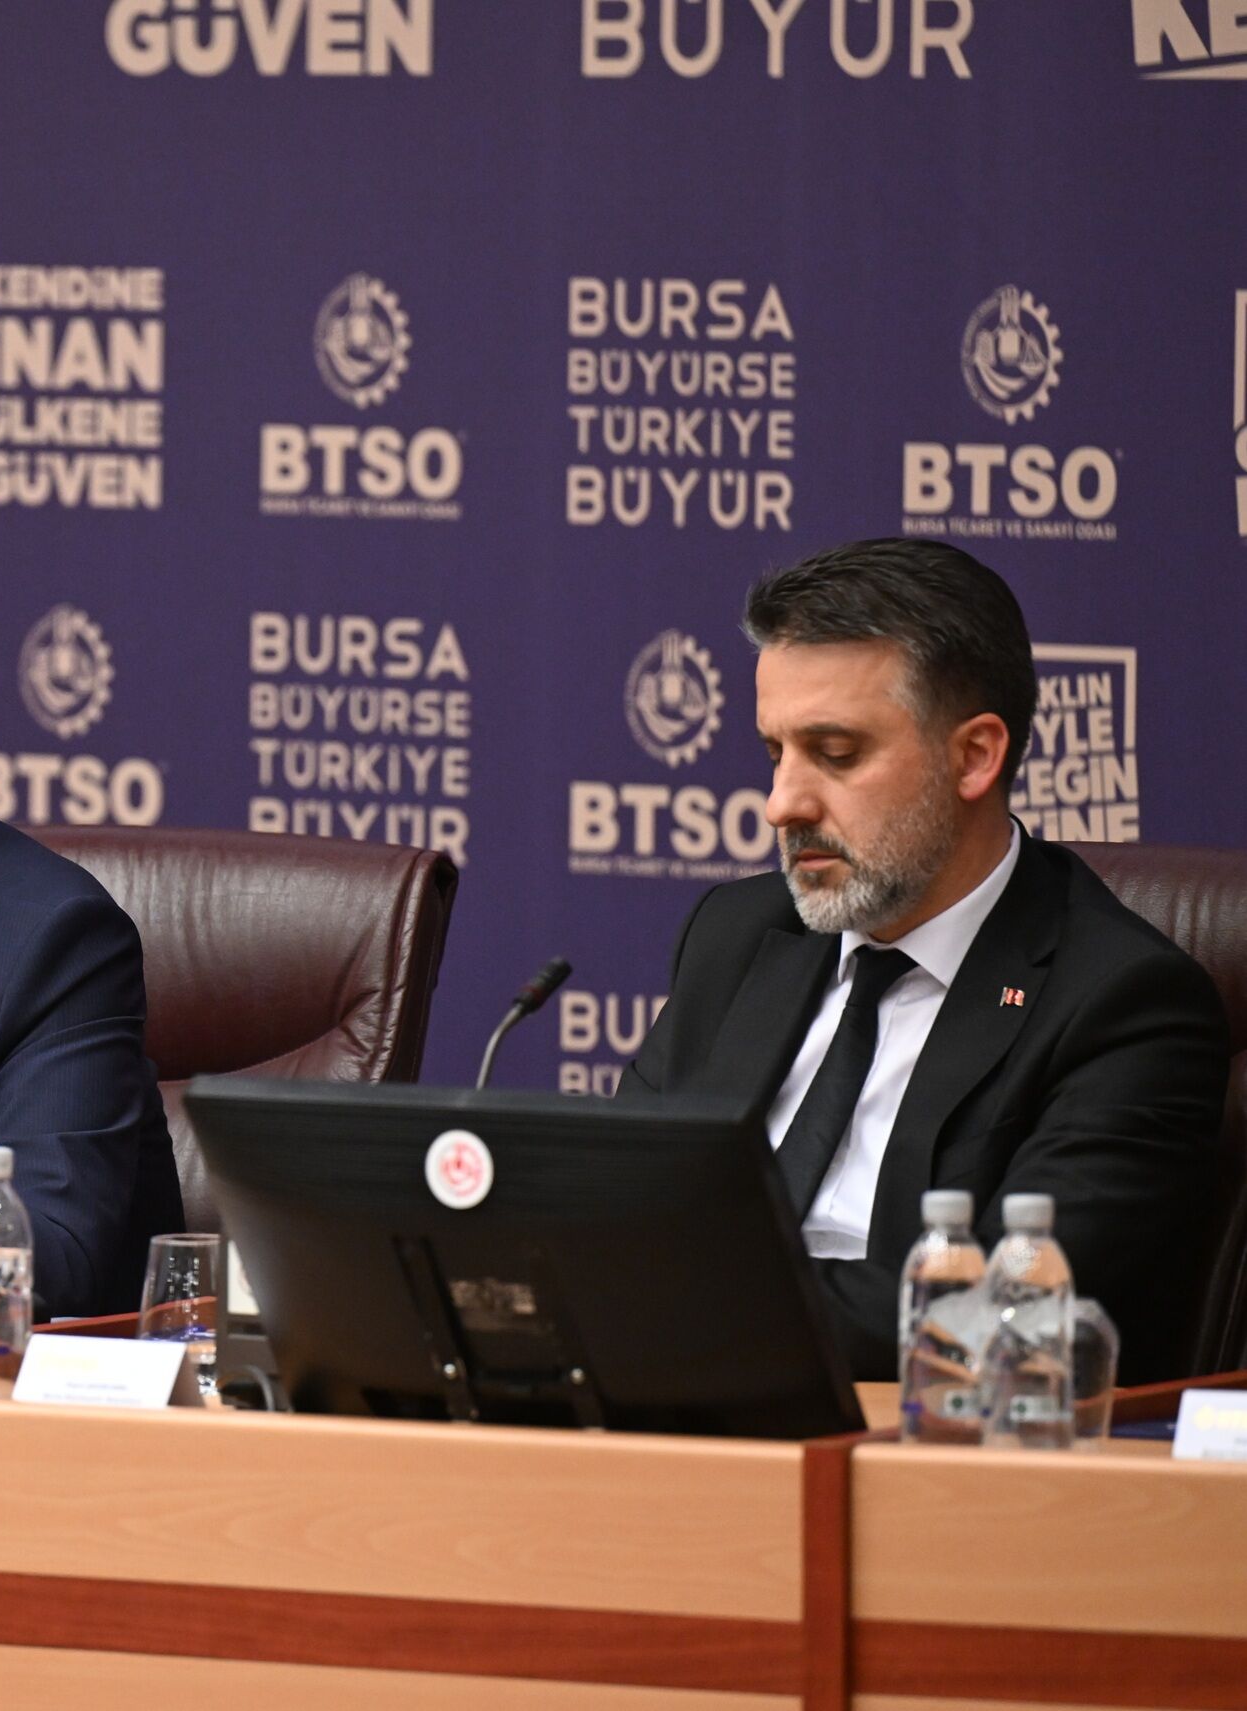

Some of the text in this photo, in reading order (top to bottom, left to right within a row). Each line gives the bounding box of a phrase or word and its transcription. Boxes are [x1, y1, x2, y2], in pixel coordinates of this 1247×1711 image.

[106, 0, 433, 77] GÜVEN
[568, 277, 794, 341] BURSA
[567, 349, 796, 399] BÜYÜRSE
[260, 424, 462, 499] BTSO
[567, 404, 795, 460] TÜRKİYE
[566, 465, 793, 531] BÜYÜR
[902, 442, 1117, 519] BTSO
[250, 612, 469, 681] BURSA
[1037, 671, 1113, 709] KLIN
[1028, 708, 1115, 757] YLE
[569, 780, 775, 863] BTSO
